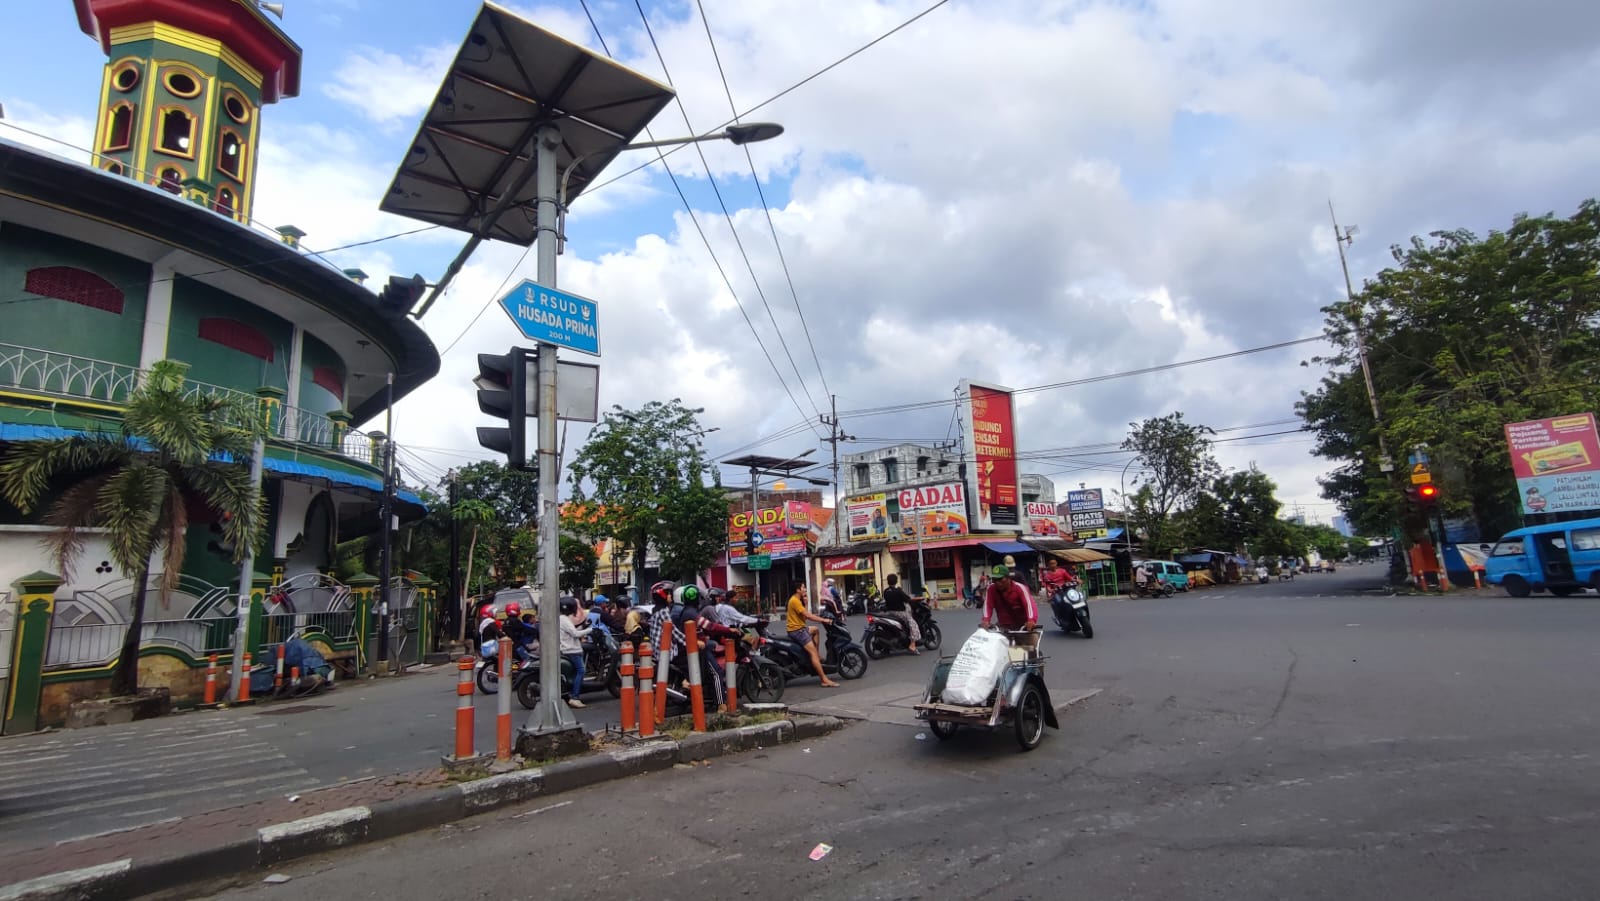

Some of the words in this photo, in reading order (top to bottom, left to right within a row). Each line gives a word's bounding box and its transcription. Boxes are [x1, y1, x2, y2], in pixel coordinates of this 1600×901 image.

[540, 293, 577, 315] RSUD
[518, 303, 563, 329] HUSADA
[565, 318, 596, 339] PRIMA
[549, 331, 563, 340] 200
[1511, 435, 1550, 444] Pantang
[1513, 440, 1559, 450] Tumbang!
[899, 484, 963, 509] GADAI
[1028, 503, 1055, 516] GADAI
[1072, 512, 1103, 521] GRATIS
[1072, 519, 1104, 527] ONGKIR
